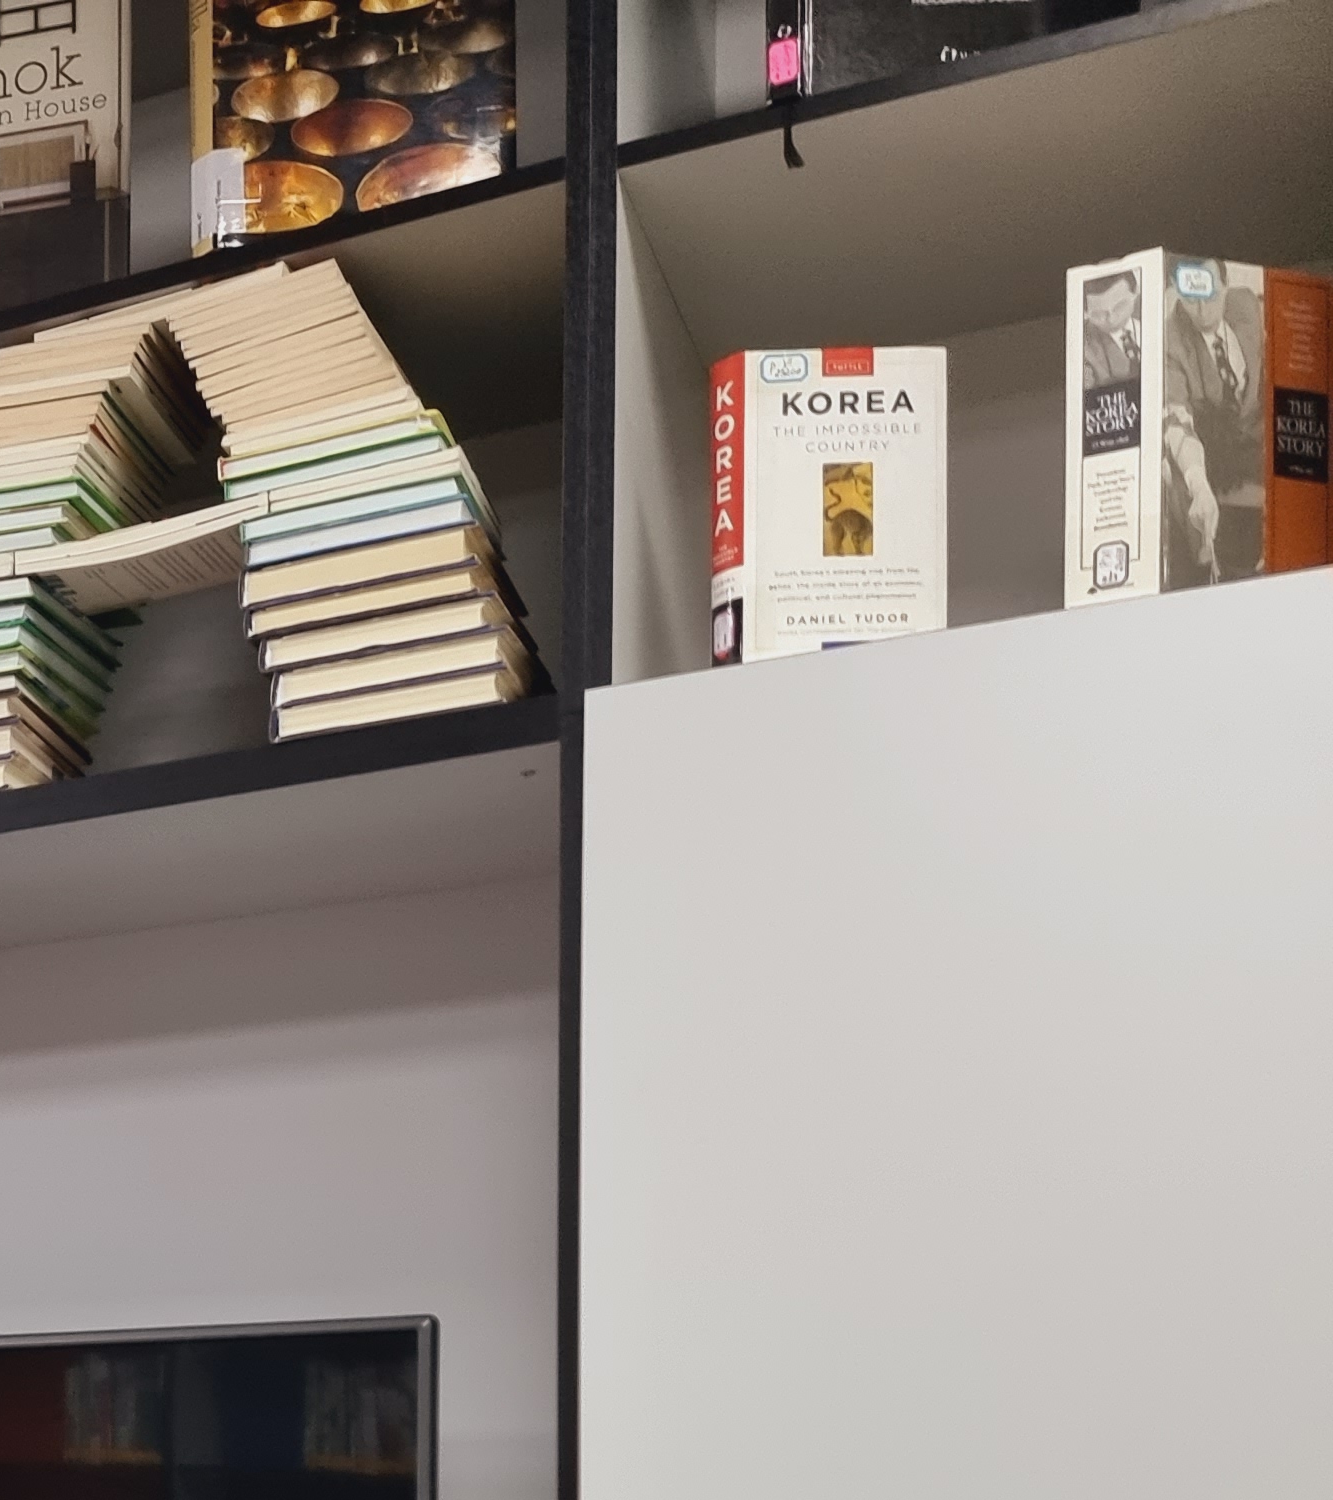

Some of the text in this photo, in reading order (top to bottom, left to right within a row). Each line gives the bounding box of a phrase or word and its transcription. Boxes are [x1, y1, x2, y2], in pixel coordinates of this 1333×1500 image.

[25, 93, 107, 121] House
[782, 389, 915, 416] KOREA
[1097, 391, 1127, 408] THE
[1289, 399, 1317, 418] THE
[1085, 402, 1139, 424] KOREA
[773, 422, 922, 438] THE IMPOSSIBLE
[1085, 416, 1135, 436] STORY
[1276, 417, 1326, 438] KOREA
[805, 440, 890, 453] COUNTRY
[1276, 436, 1326, 458] STORY
[714, 381, 734, 537] KOREA
[786, 612, 909, 625] DANIEL TUDOR
